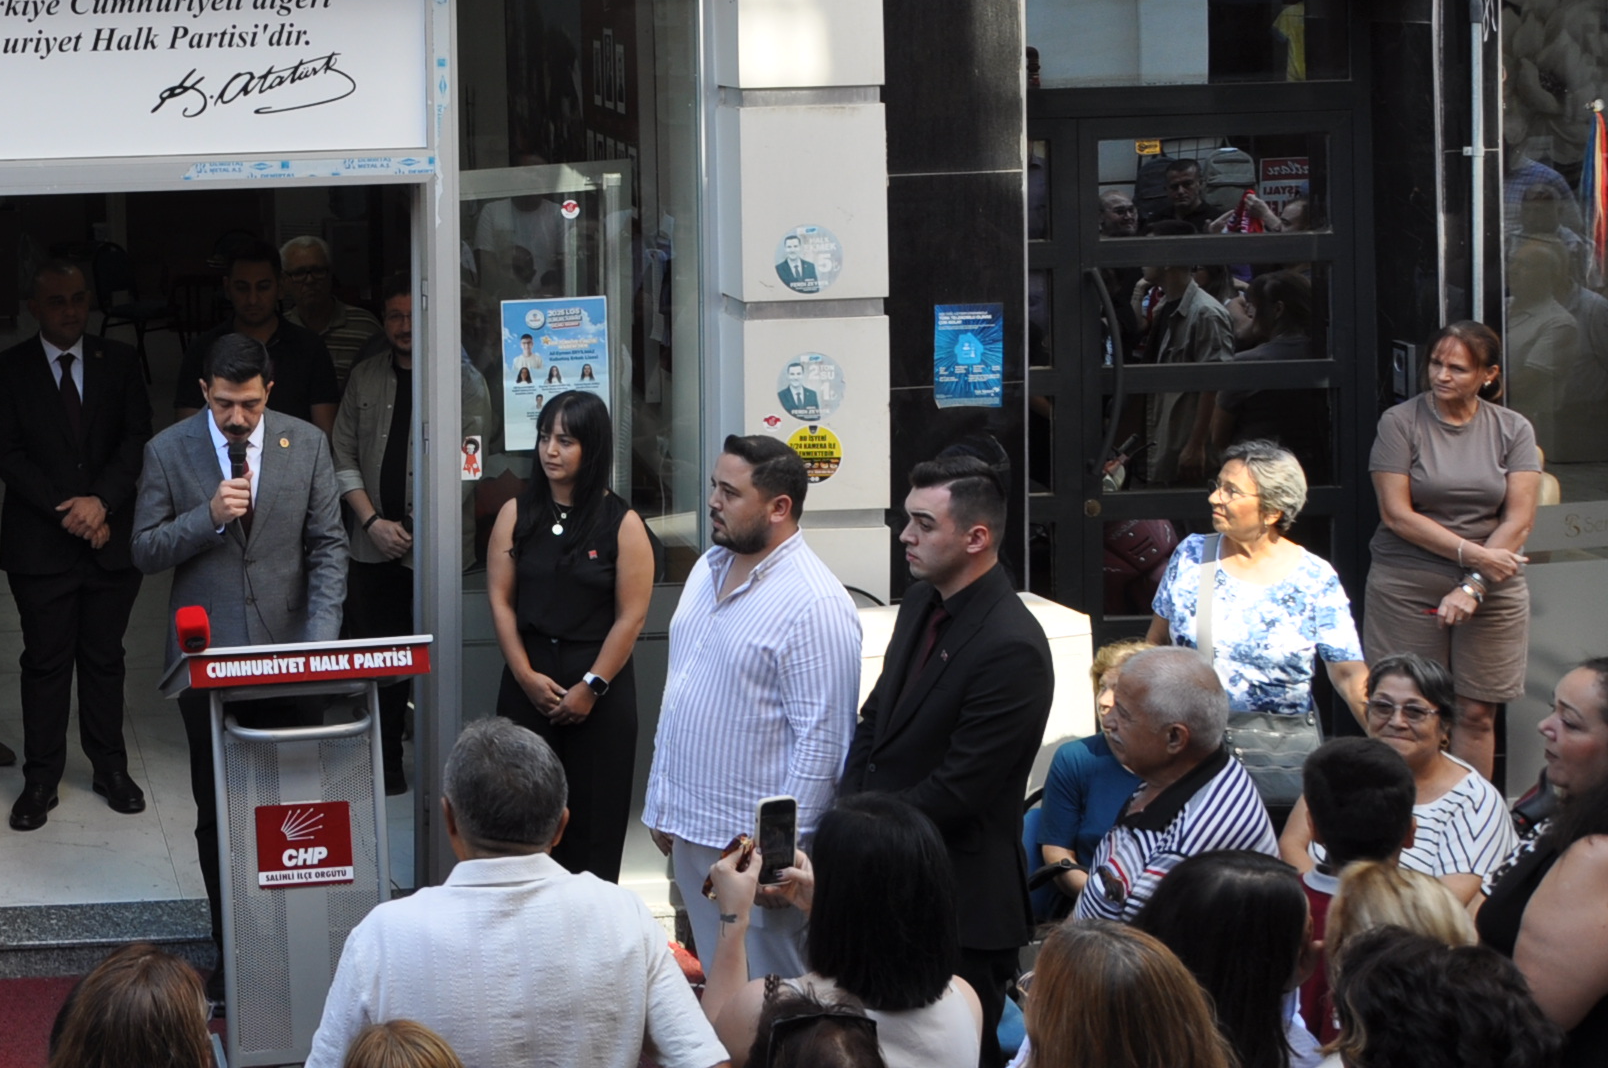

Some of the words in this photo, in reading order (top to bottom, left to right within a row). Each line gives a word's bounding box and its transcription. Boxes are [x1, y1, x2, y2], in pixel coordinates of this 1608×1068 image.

[89, 26, 160, 52] Halk
[167, 23, 311, 50] Partisi'dir.
[206, 654, 305, 679] CUMHURİYET
[310, 652, 350, 673] HALK
[353, 646, 413, 669] PARTİSİ
[282, 846, 328, 867] CHP
[265, 872, 295, 882] SALİHLİ
[296, 870, 312, 882] İLÇE
